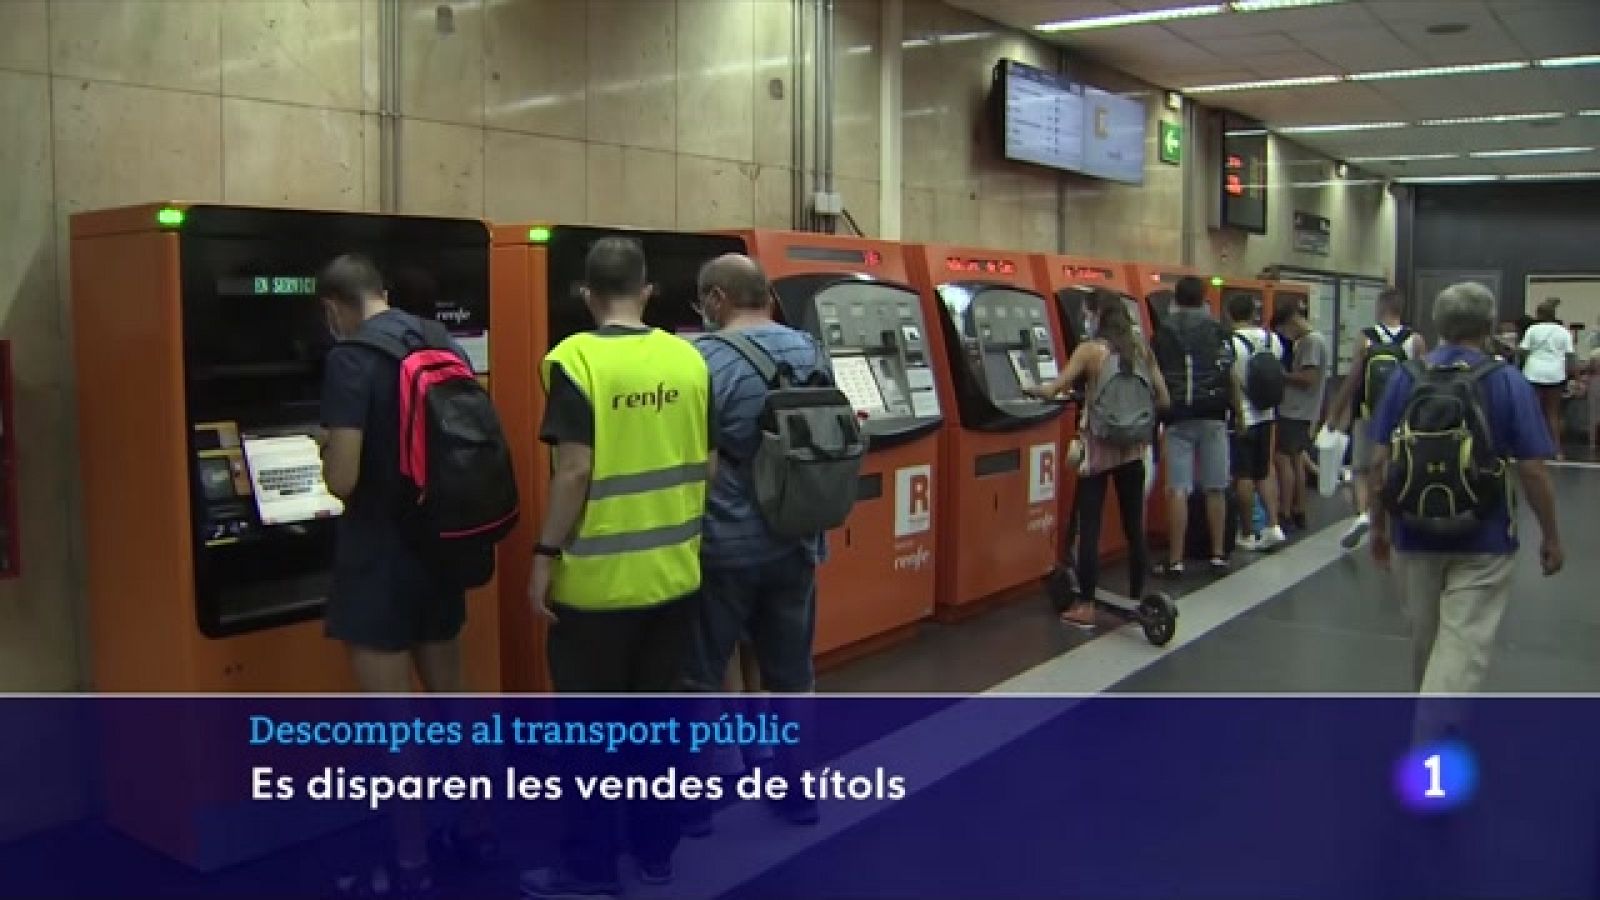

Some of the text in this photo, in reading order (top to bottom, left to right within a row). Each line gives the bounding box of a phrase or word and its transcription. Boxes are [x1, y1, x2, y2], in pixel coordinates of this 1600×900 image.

[612, 382, 679, 413] renfe
[1039, 449, 1054, 486] R
[909, 473, 930, 515] R
